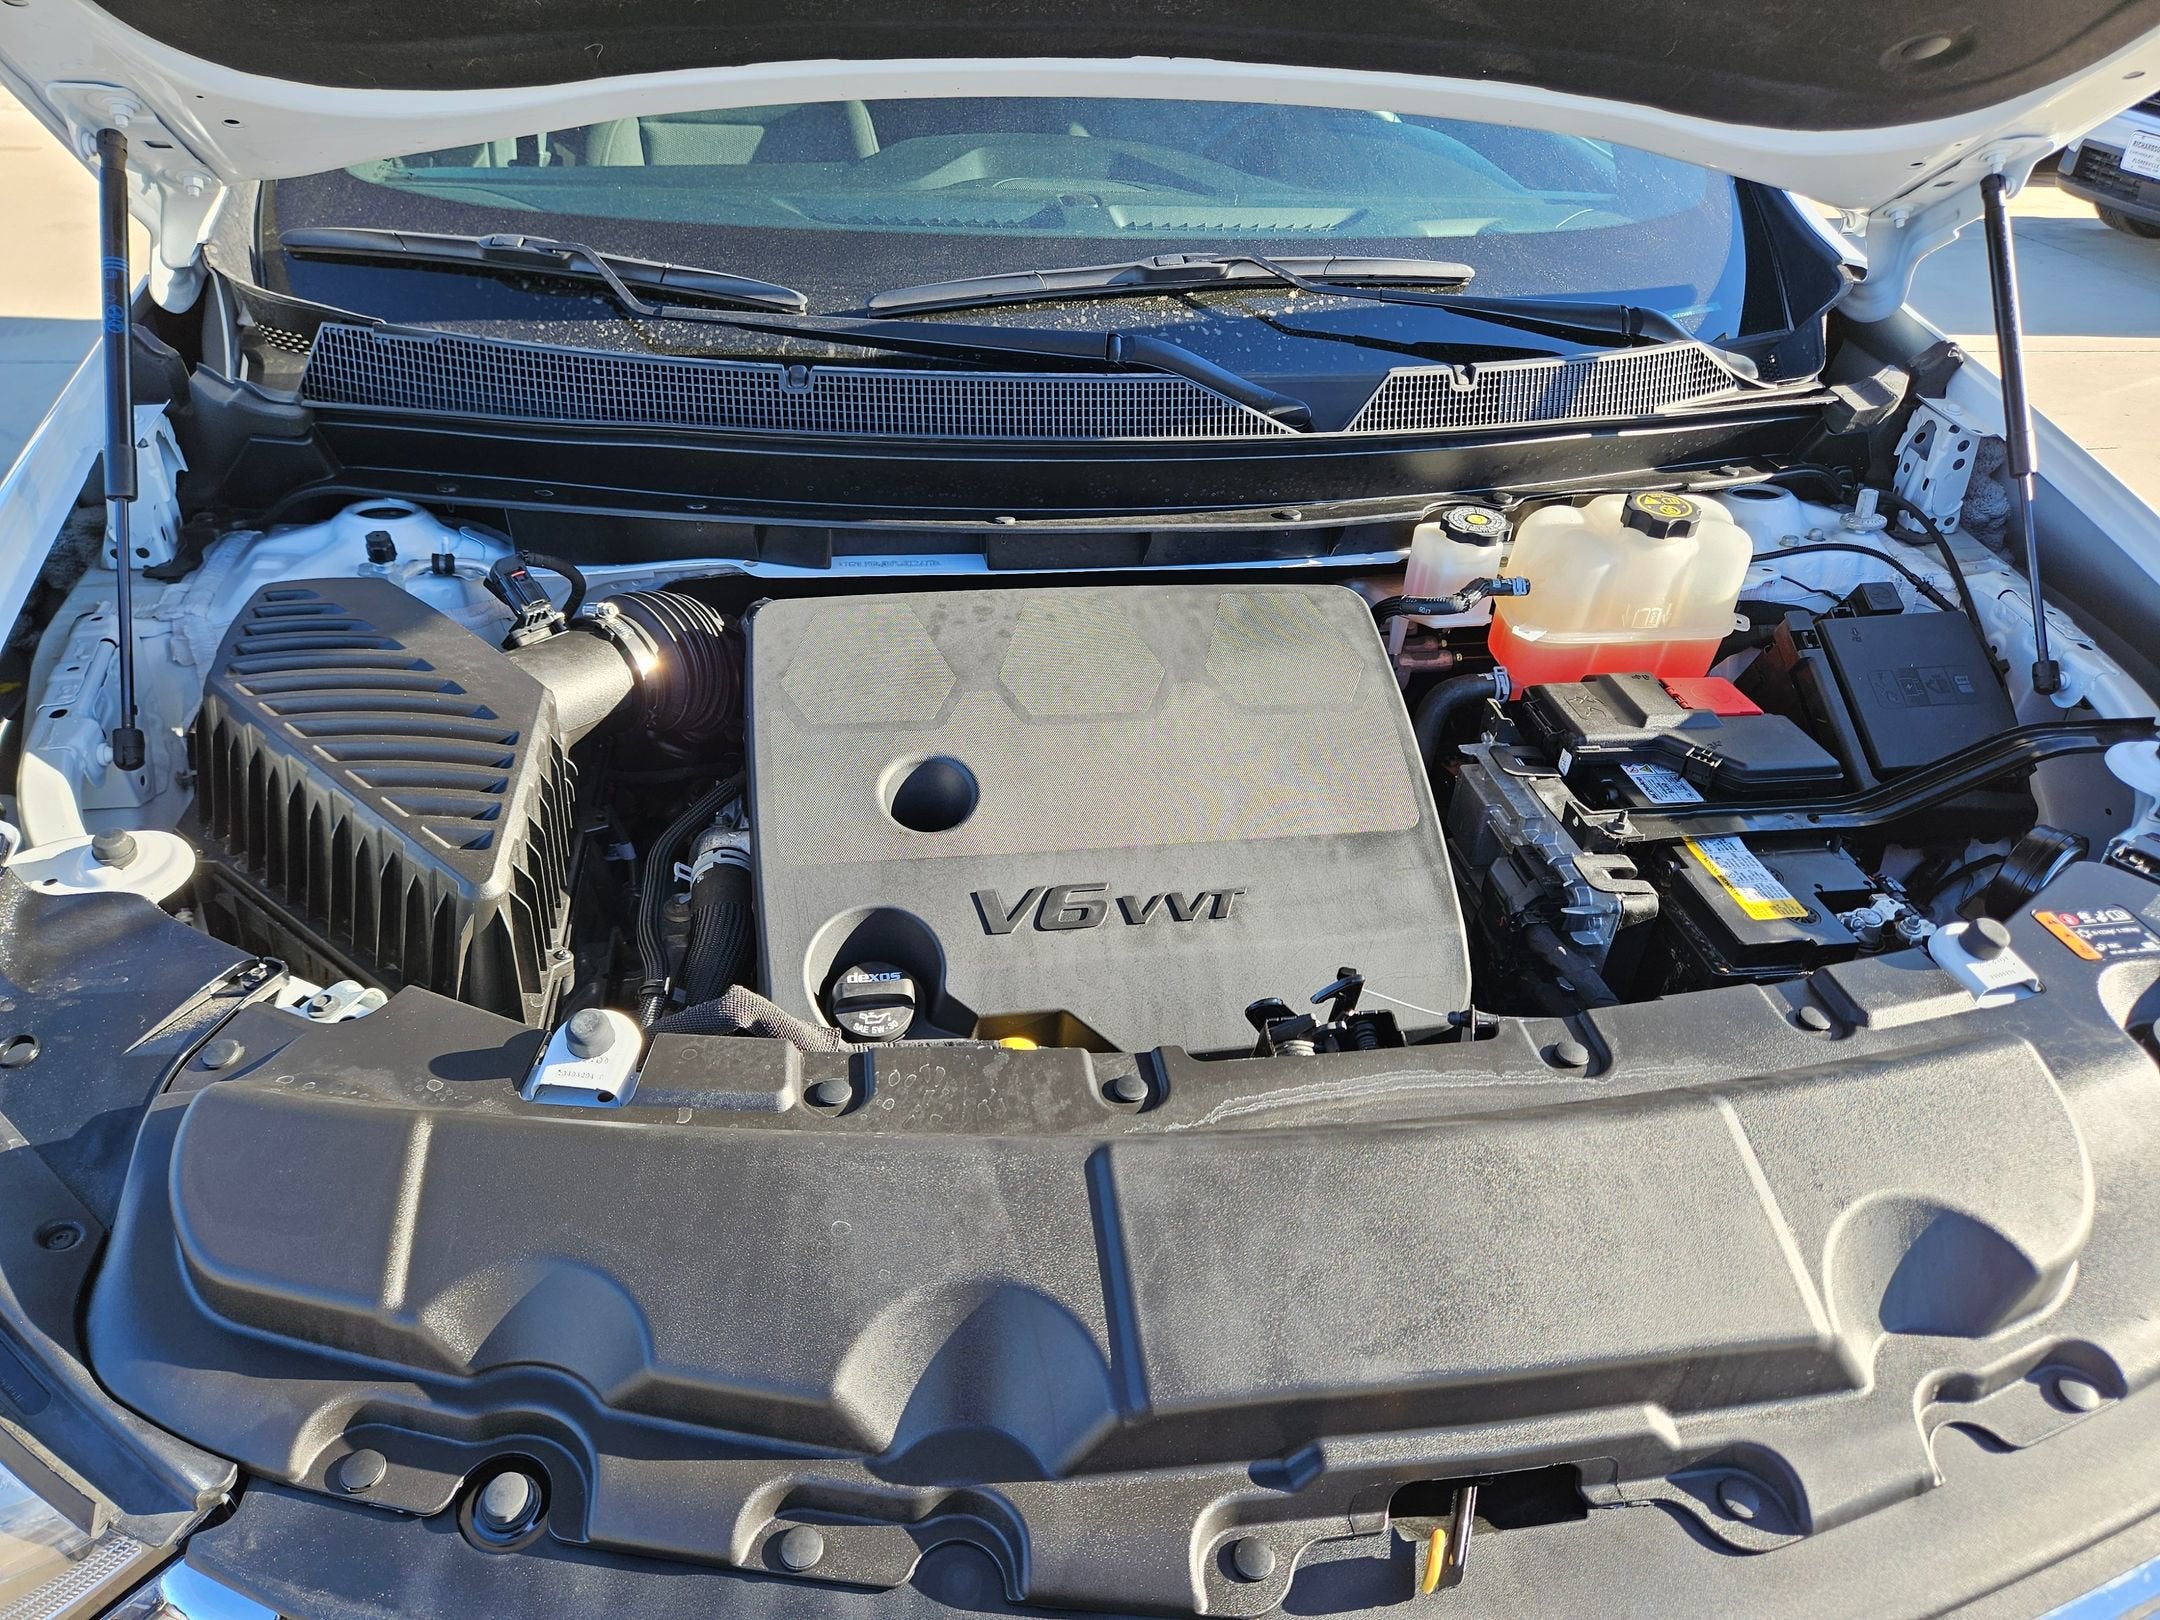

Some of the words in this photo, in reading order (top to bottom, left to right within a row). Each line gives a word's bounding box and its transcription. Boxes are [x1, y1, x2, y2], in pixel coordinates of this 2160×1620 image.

[969, 882, 1110, 936] V6
[1115, 887, 1248, 926] VVT
[846, 971, 902, 984] dexos
[853, 1022, 869, 1033] SAE
[871, 1020, 899, 1034] 5W-30
